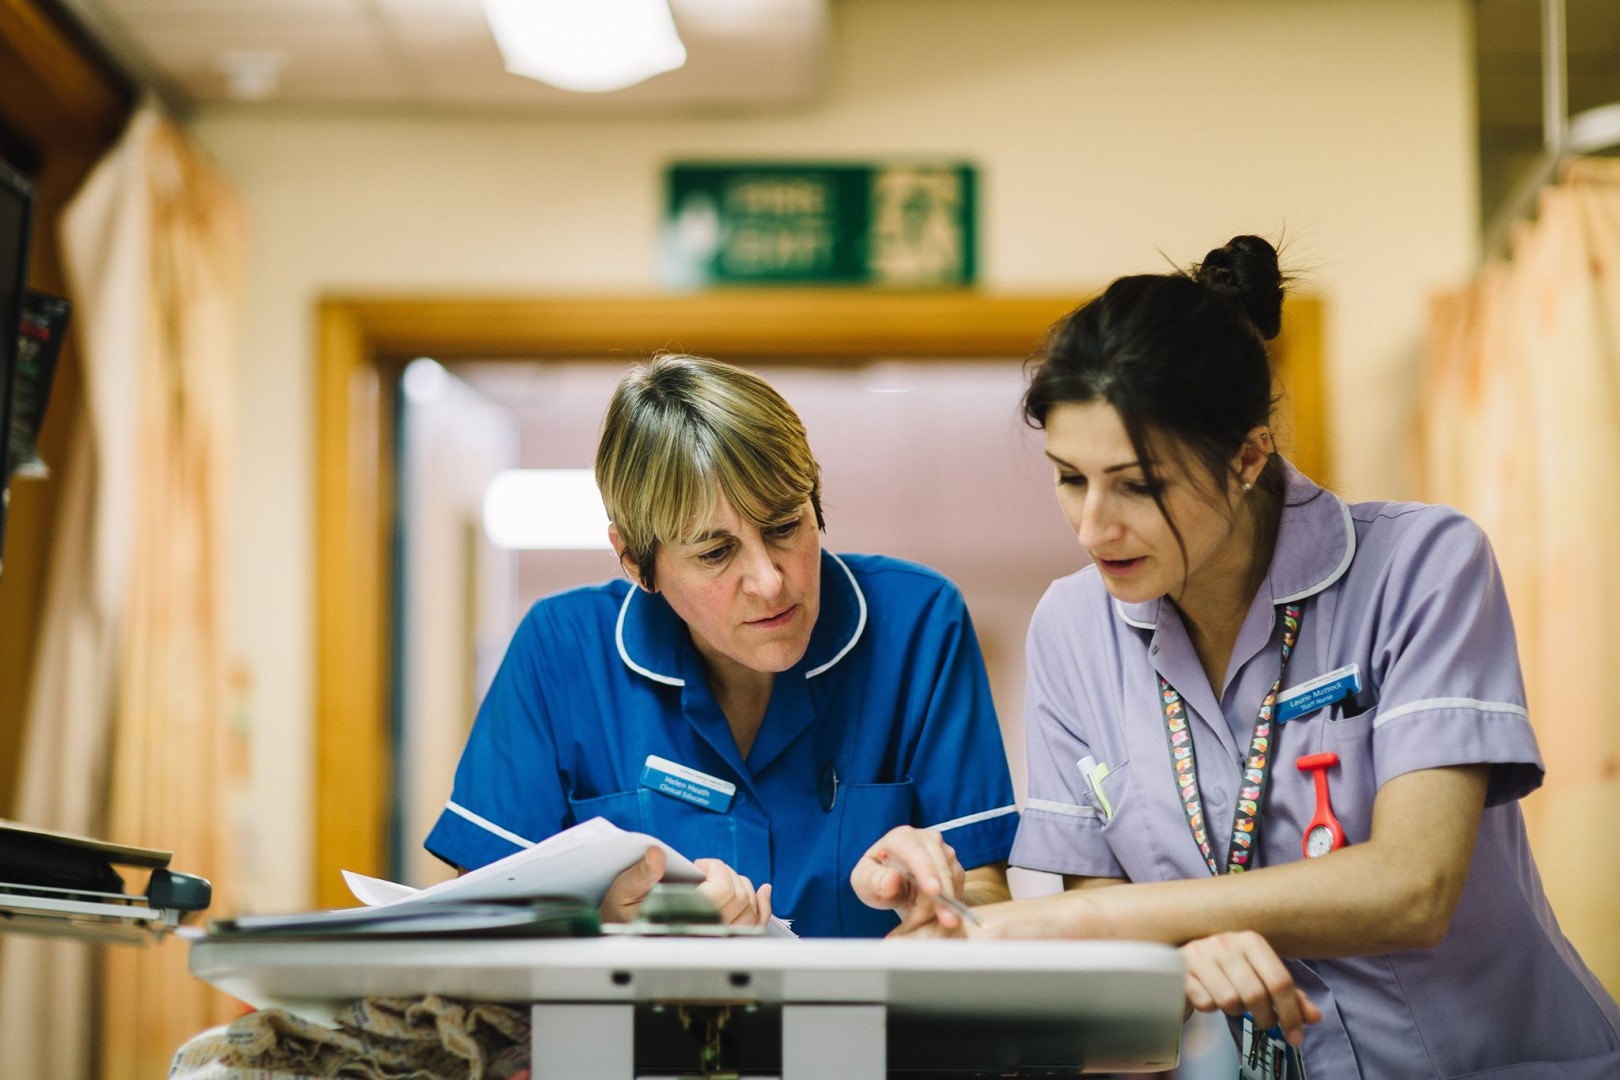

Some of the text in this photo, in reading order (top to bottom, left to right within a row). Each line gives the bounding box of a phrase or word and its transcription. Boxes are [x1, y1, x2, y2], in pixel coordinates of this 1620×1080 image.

[1289, 681, 1343, 708] Laurie Mattock
[1301, 694, 1333, 711] Staff Nurse
[660, 783, 710, 805] Clinical Educator
[665, 776, 686, 789] Helen
[687, 784, 710, 797] Heath
